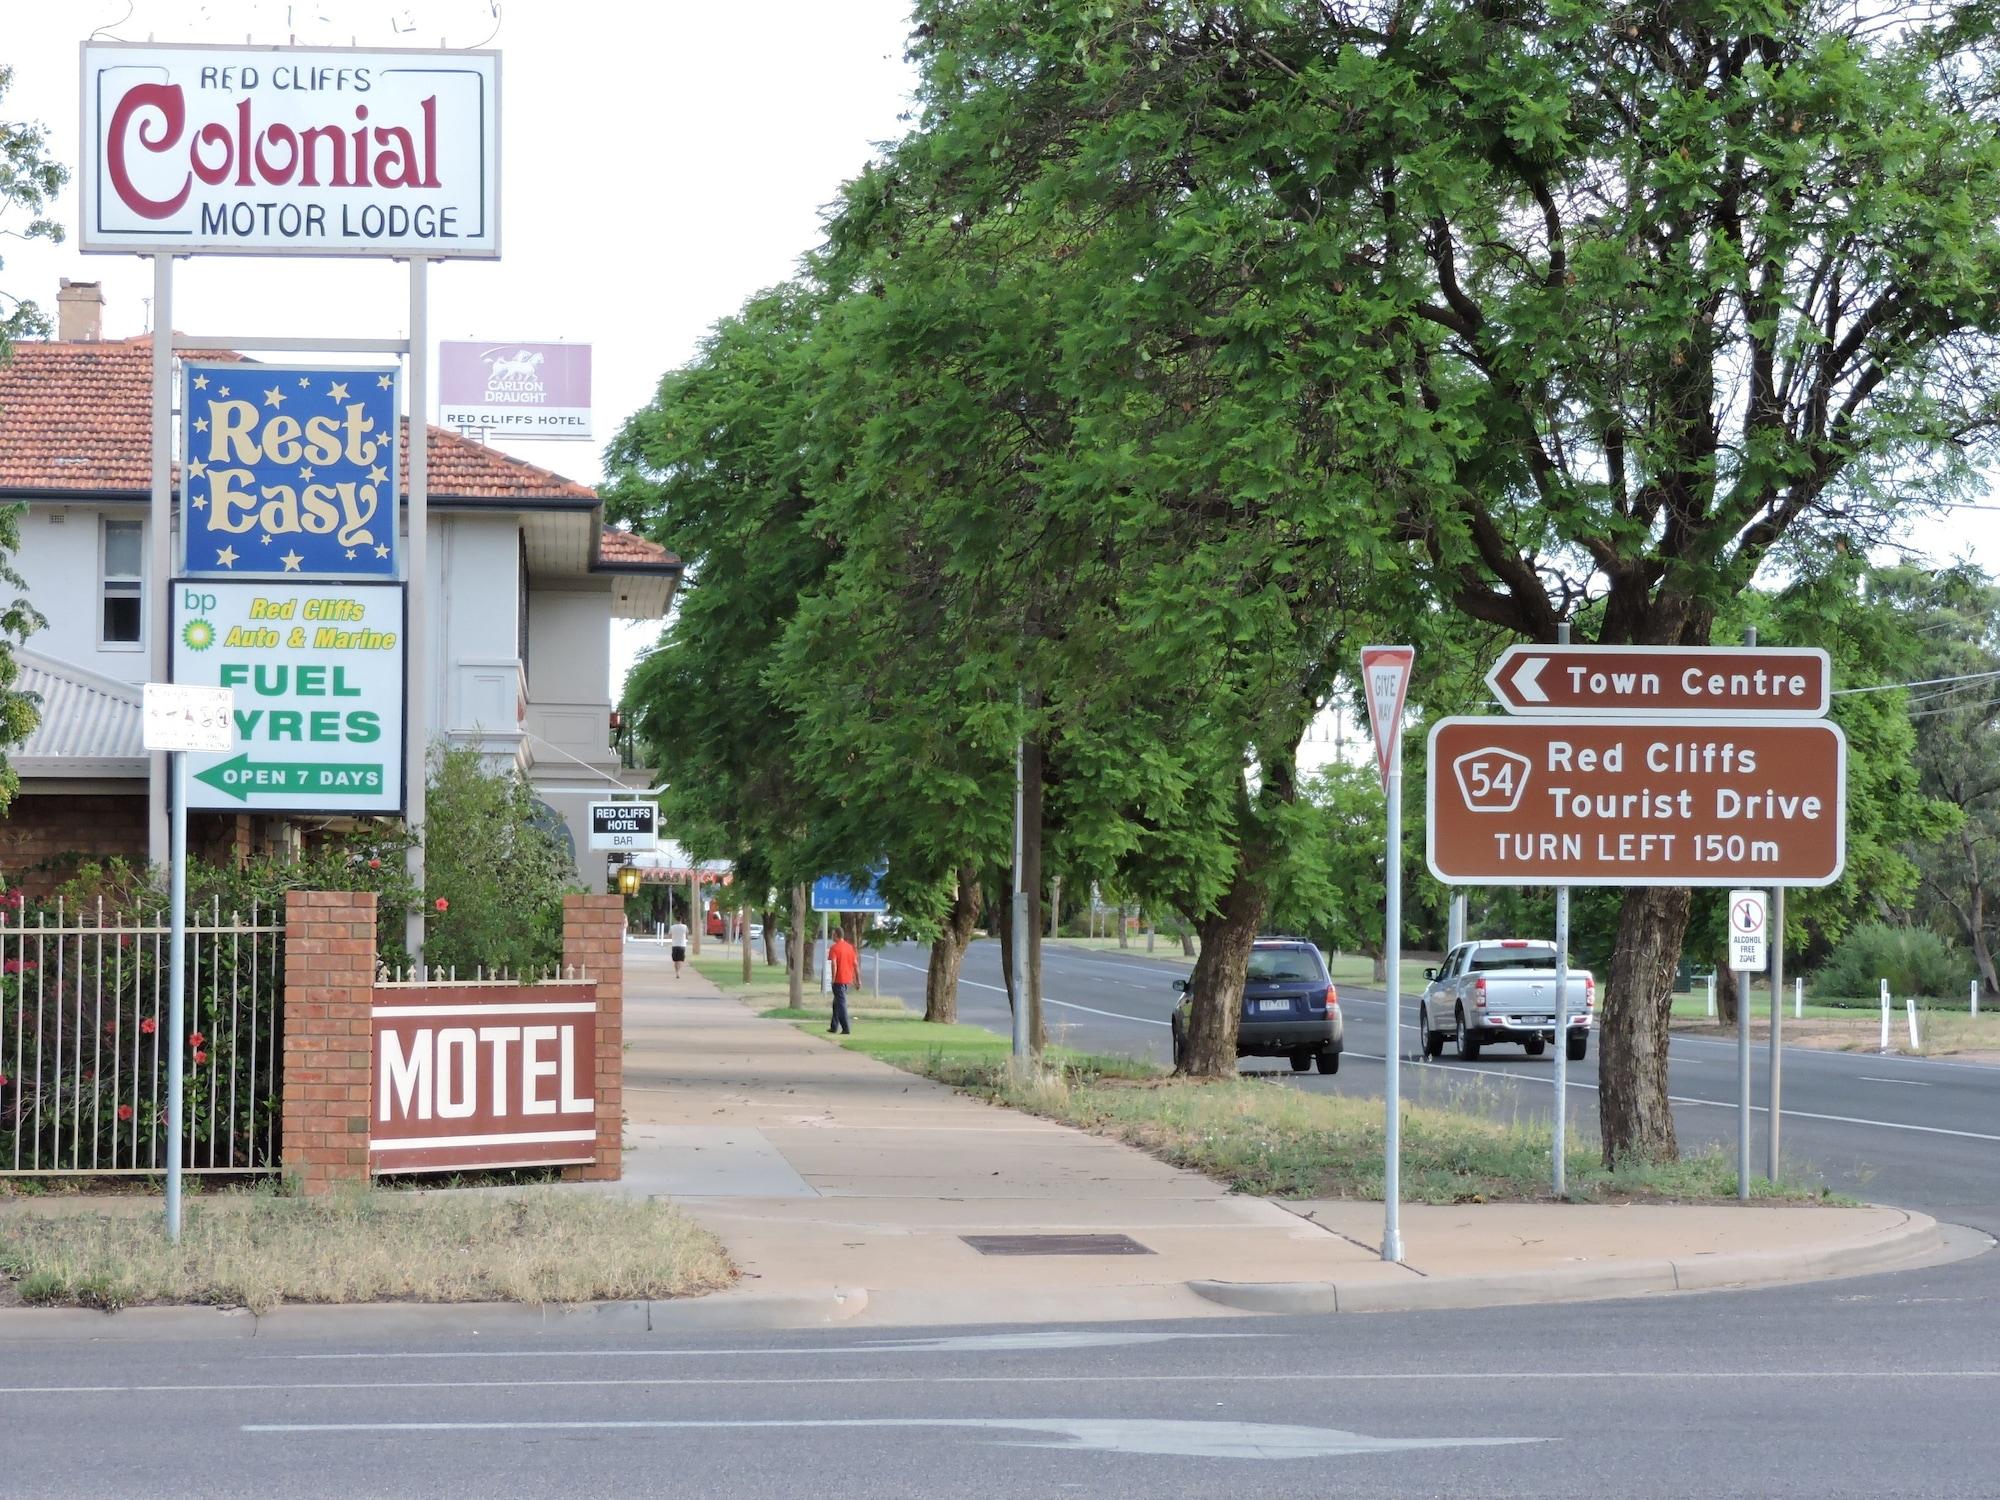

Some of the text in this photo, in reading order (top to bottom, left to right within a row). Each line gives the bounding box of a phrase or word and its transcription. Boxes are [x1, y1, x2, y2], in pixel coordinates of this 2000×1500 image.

[200, 66, 372, 92] RED CLIFFS
[106, 82, 443, 220] Colonial
[200, 202, 459, 238] MOTOR LODGE
[484, 391, 547, 403] DRAUGHT
[487, 380, 544, 392] CARLTON
[447, 414, 586, 425] RED CLIFFS HOTEL
[207, 399, 378, 467] Rest
[206, 468, 378, 547] Easy
[184, 588, 217, 615] bp
[248, 597, 366, 622] Red Cliffs
[223, 625, 397, 650] Auto & Marine
[220, 663, 361, 697] FUEL
[1375, 674, 1396, 697] GIVE
[1566, 666, 1807, 696] Town Centre
[1377, 703, 1393, 721] WAY
[233, 709, 382, 744] YRES
[1547, 741, 1757, 774] Red Cliffs
[222, 769, 379, 786] OPEN 7 DAYS
[1470, 762, 1514, 797] 54
[596, 808, 651, 819] RED CLIFFS
[1547, 787, 1822, 820] Tourist Drive
[607, 820, 640, 831] HOTEL
[613, 836, 633, 846] BAR
[1494, 833, 1779, 862] TURN LEFT 150m
[834, 897, 848, 905] km
[379, 1024, 595, 1122] MOTEL
